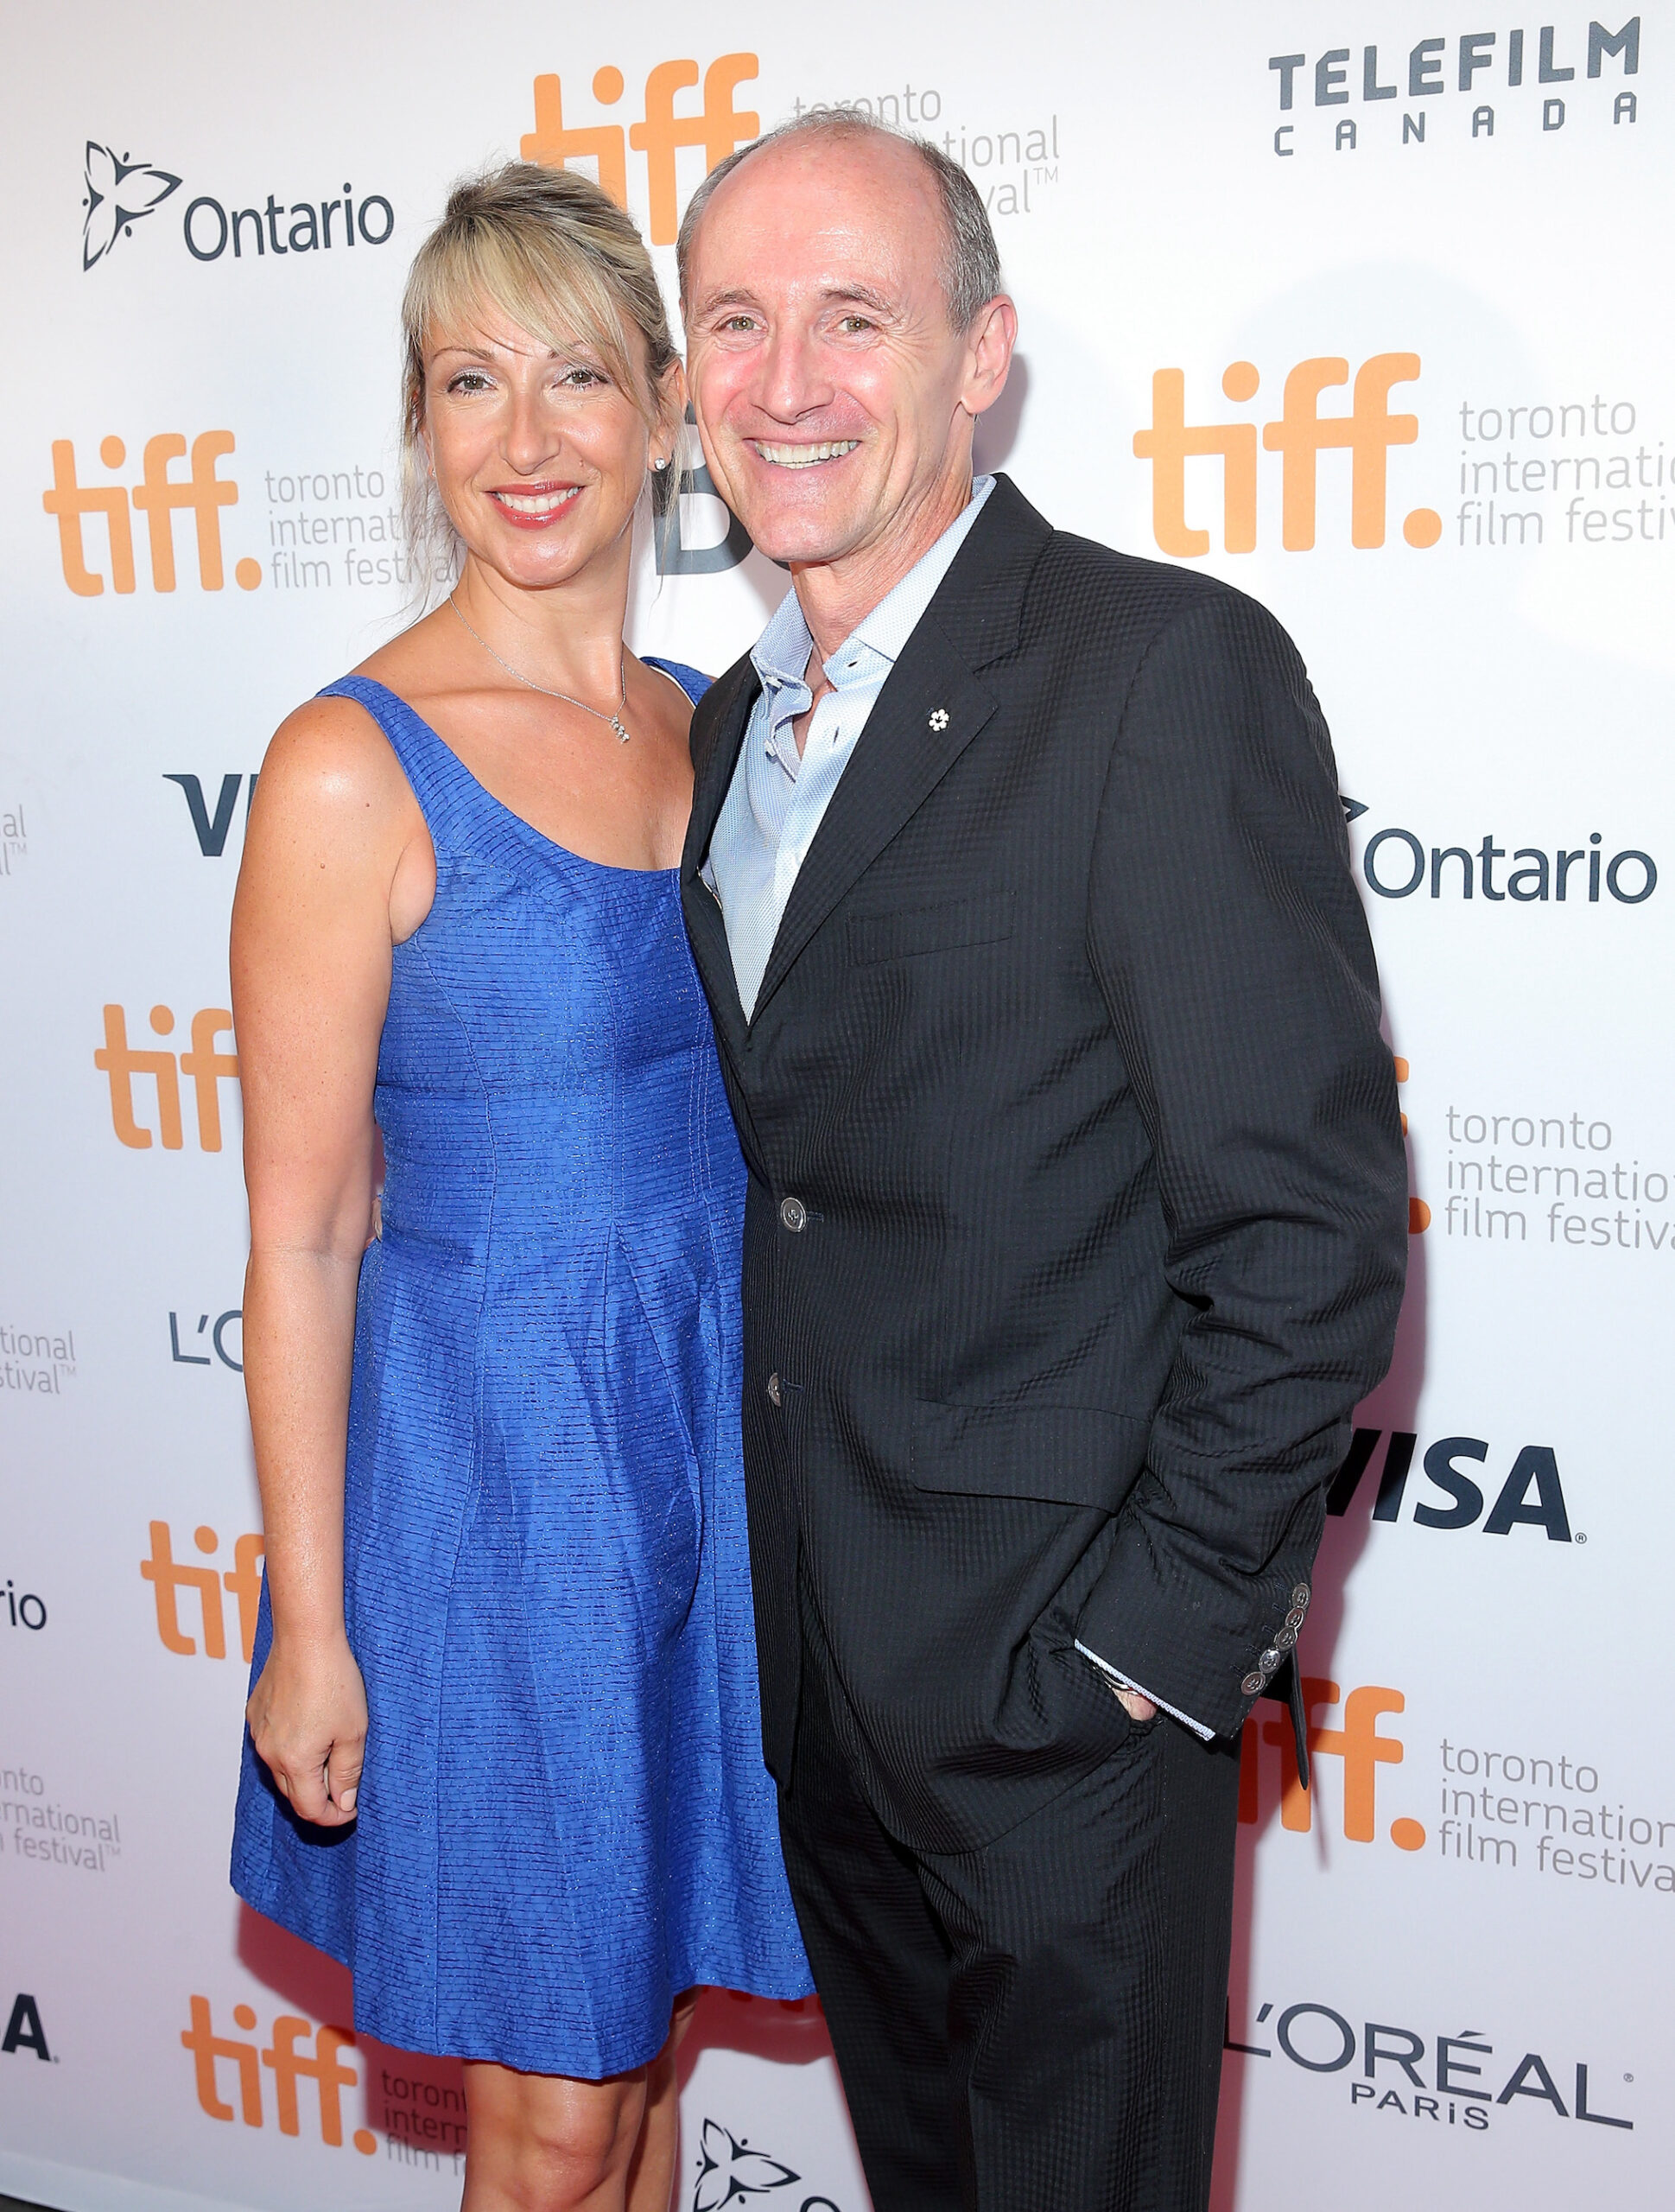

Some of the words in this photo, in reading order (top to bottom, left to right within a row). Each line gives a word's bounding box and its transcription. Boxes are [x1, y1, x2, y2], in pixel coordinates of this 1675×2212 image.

[1268, 16, 1640, 111] TELEFILM
[793, 84, 942, 125] tnto
[1274, 92, 1637, 156] CANADA
[183, 182, 394, 262] Ontario
[1459, 394, 1636, 442] toronto
[264, 465, 384, 503] toronto
[1460, 442, 1675, 495] internati
[1456, 500, 1543, 546] film
[1565, 495, 1675, 543] festi
[271, 550, 331, 589] film
[162, 773, 259, 856] V
[1363, 828, 1658, 905] Ontario
[94, 1003, 240, 1153] tif
[1445, 1105, 1612, 1151] toronto
[1447, 1149, 1675, 1203] internatio
[1444, 1195, 1526, 1241] film
[1547, 1202, 1675, 1250] festiv
[0, 1767, 44, 1796] nto
[1440, 1738, 1598, 1794] toronto
[0, 1801, 121, 1844] rnational
[1438, 1819, 1517, 1867] film
[387, 2132, 440, 2172] film
